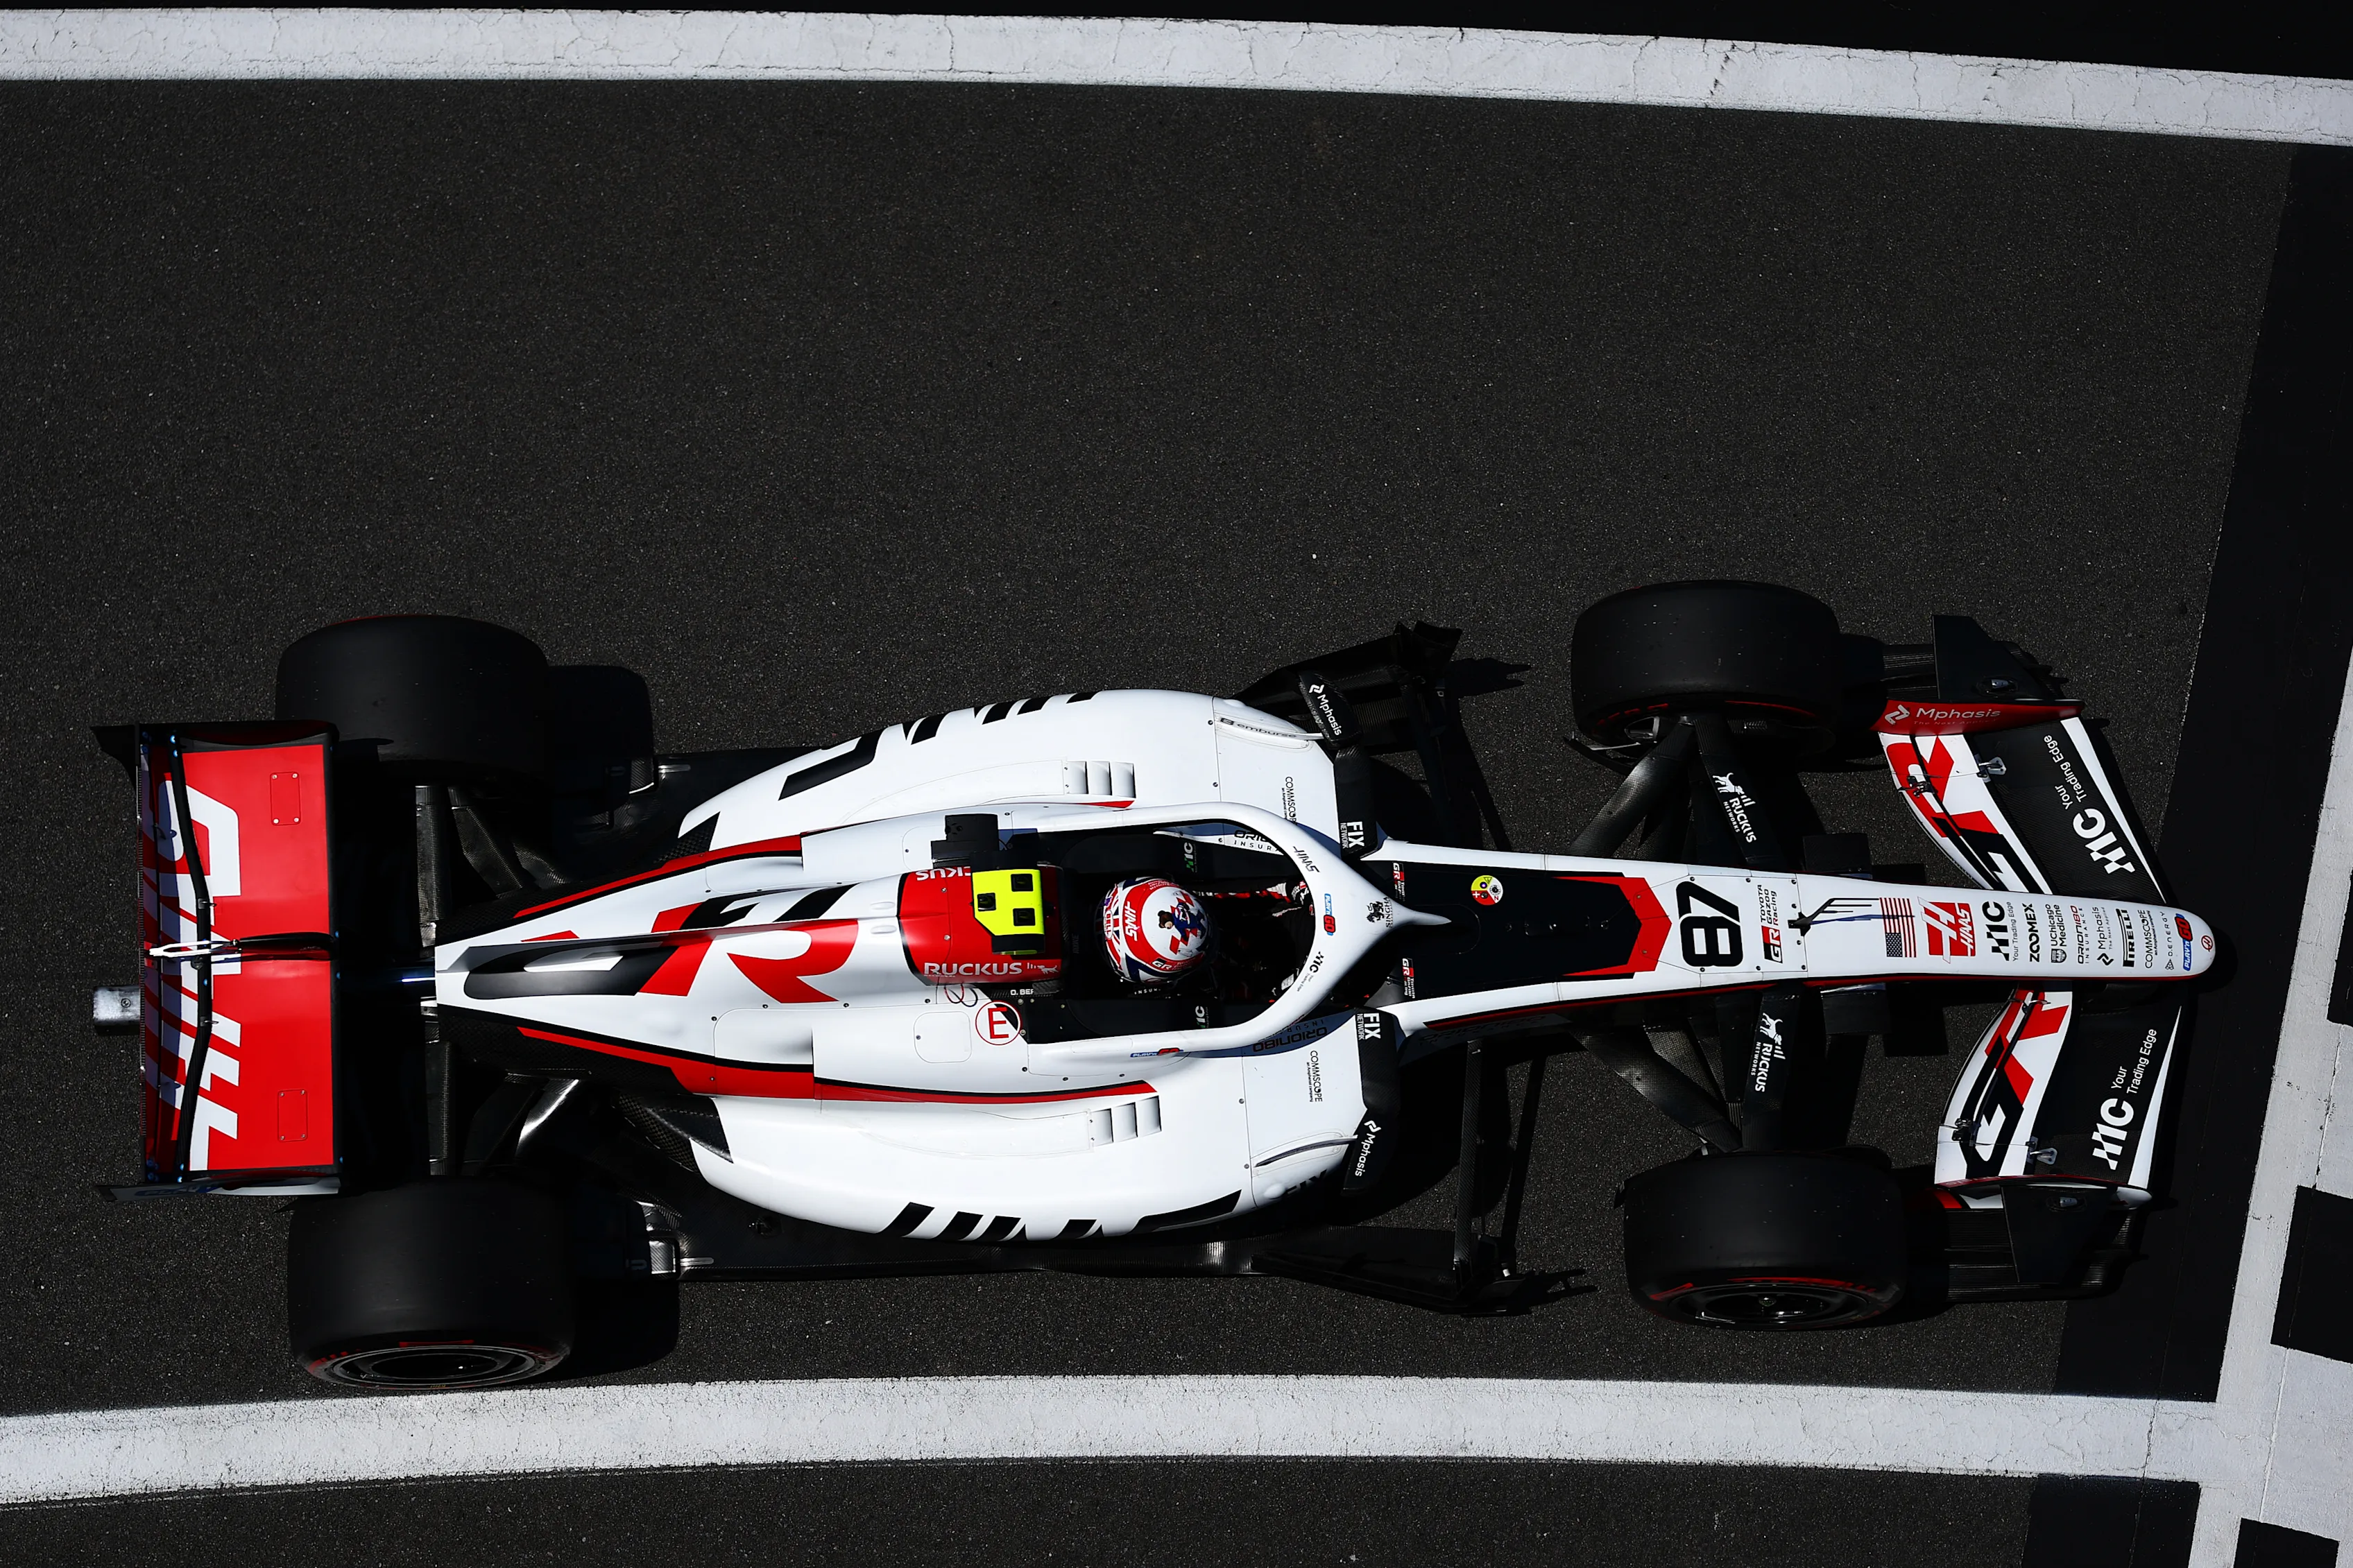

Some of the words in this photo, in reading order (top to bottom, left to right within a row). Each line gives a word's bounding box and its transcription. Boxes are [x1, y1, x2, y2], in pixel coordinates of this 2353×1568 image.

[1237, 723, 1297, 739] emburse
[1317, 695, 1342, 736] Mphasis
[1916, 707, 2001, 721] Mphasis
[2044, 734, 2064, 764] Edge
[2055, 785, 2073, 809] Your
[2060, 761, 2087, 802] Trading
[1347, 821, 1364, 847] FIX
[1722, 801, 1740, 833] NETWORKS
[1729, 798, 1756, 843] RUCKUS
[1340, 822, 1348, 849] NETWORK
[915, 867, 971, 881] CKUS
[1393, 862, 1401, 880] GR
[1757, 884, 1766, 922] TOYOTA
[1764, 888, 1772, 924] GAZOO
[1770, 890, 1779, 926] Racing
[2006, 902, 2015, 917] Edge
[1675, 881, 1744, 967] 87
[1957, 904, 1974, 954] HAAS
[2010, 919, 2018, 944] Trading
[2022, 903, 2040, 963] ZOOMEX
[2045, 904, 2058, 946] UChicago
[2053, 904, 2068, 947] Medicine
[2079, 907, 2089, 964] INSURANCE
[2091, 907, 2107, 949] Mphasis
[2116, 908, 2134, 967] PIRELLI
[2138, 909, 2153, 969] COMMSCOPE
[2176, 917, 2192, 940] GO
[1767, 928, 1782, 963] GR
[924, 962, 1023, 976] RUCKUS
[1402, 958, 1410, 976] GR
[988, 1006, 1009, 1040] E
[1356, 1013, 1364, 1041] NETWORK
[1364, 1013, 1380, 1040] FIX
[1749, 1041, 1762, 1076] NETWORKS
[1755, 1043, 1773, 1092] RUCKUS
[2127, 1056, 2150, 1095] Trading
[2139, 1028, 2157, 1055] Edge
[1310, 1050, 1323, 1103] COMMSCOPE
[2111, 1066, 2128, 1089] Your
[1354, 1133, 1377, 1177] Mphasis
